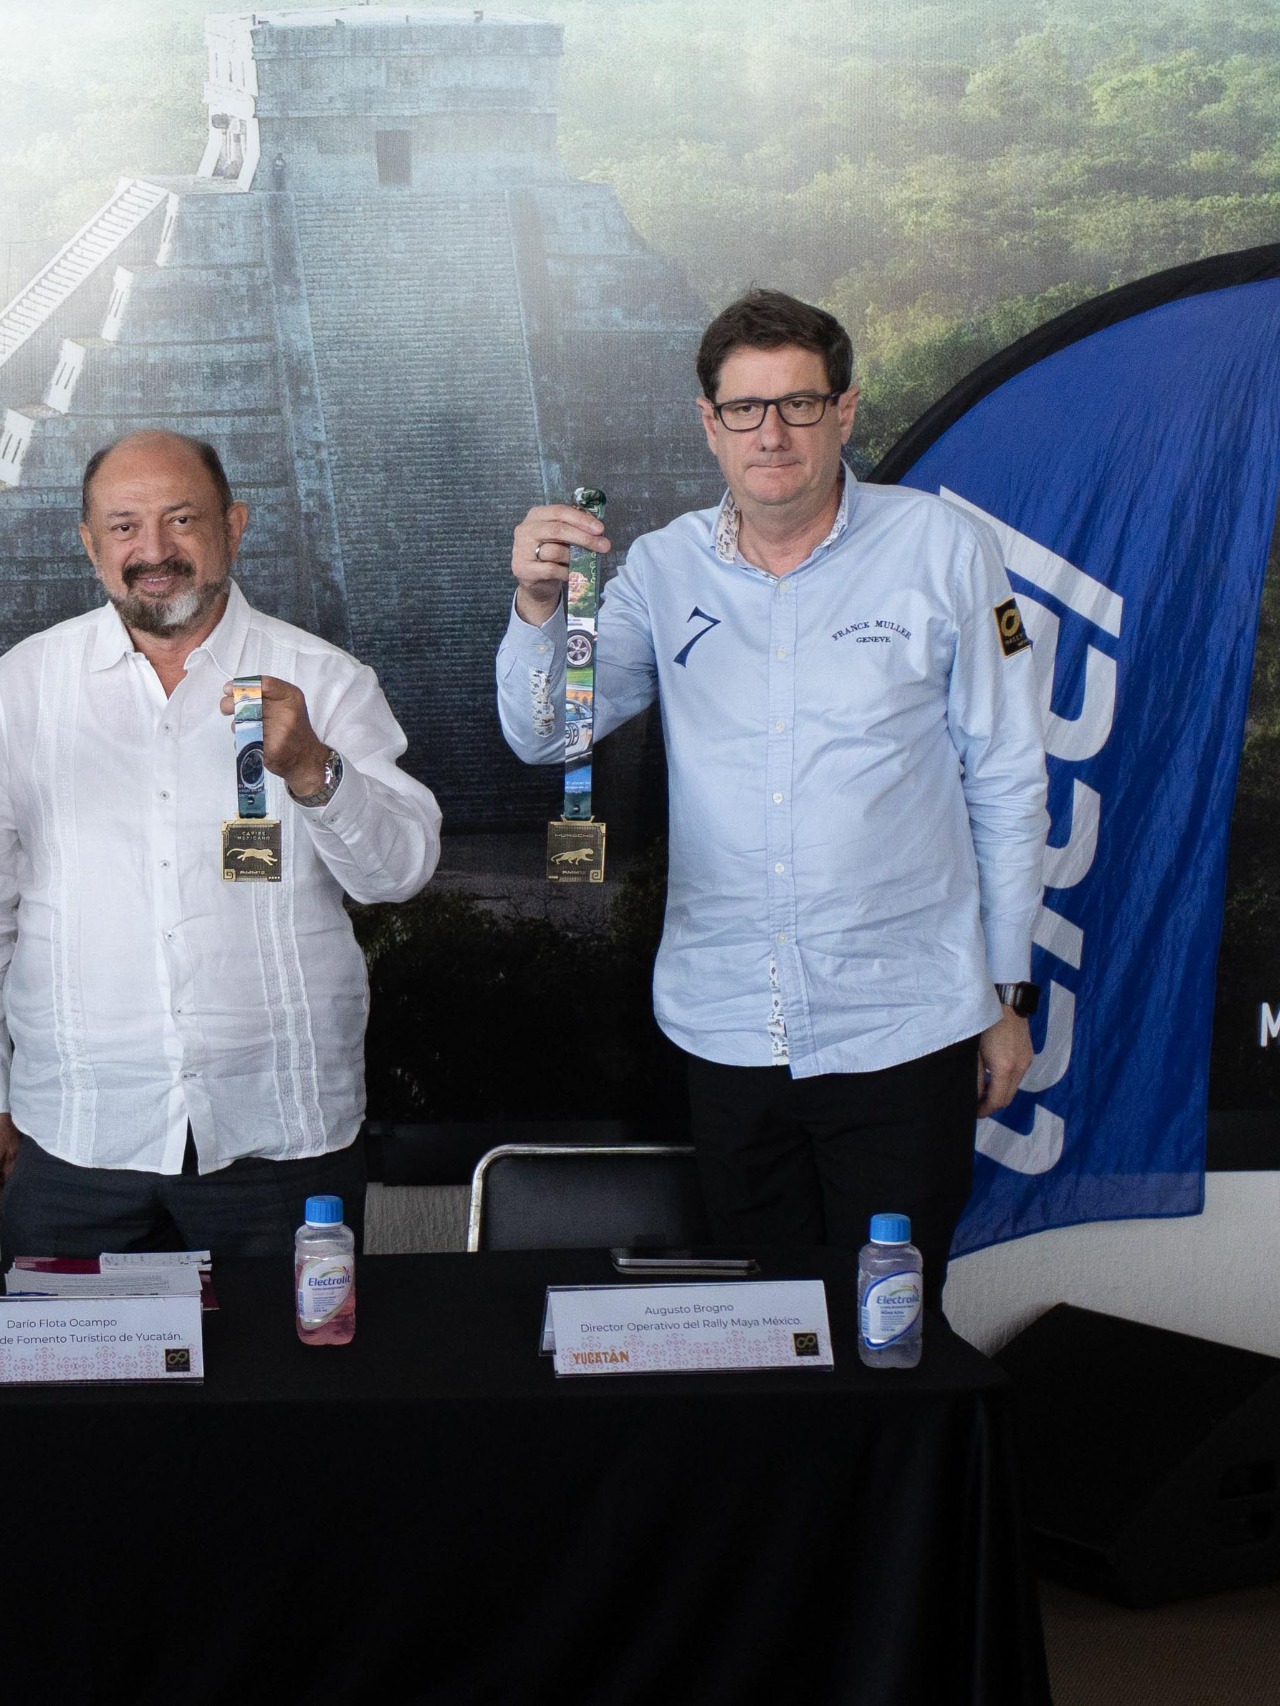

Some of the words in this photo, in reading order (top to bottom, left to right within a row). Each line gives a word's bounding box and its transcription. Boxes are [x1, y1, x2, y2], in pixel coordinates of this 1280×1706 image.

[673, 605, 722, 669] 7
[831, 621, 870, 641] FRANCK
[875, 619, 912, 640] MULLER
[308, 1275, 352, 1287] Electrolit
[644, 1305, 692, 1317] Augusto
[693, 1304, 735, 1314] Brogno
[39, 1318, 67, 1328] Flota
[69, 1318, 118, 1329] Ocampo
[580, 1323, 625, 1333] Director
[626, 1321, 681, 1333] Operativo
[682, 1319, 700, 1330] del
[702, 1318, 729, 1330] Rally
[730, 1318, 760, 1329] Maya
[0, 1335, 14, 1345] de
[16, 1335, 68, 1345] Fomento
[69, 1333, 120, 1344] Turístico
[121, 1331, 134, 1343] de
[135, 1331, 184, 1342] Yucatán.
